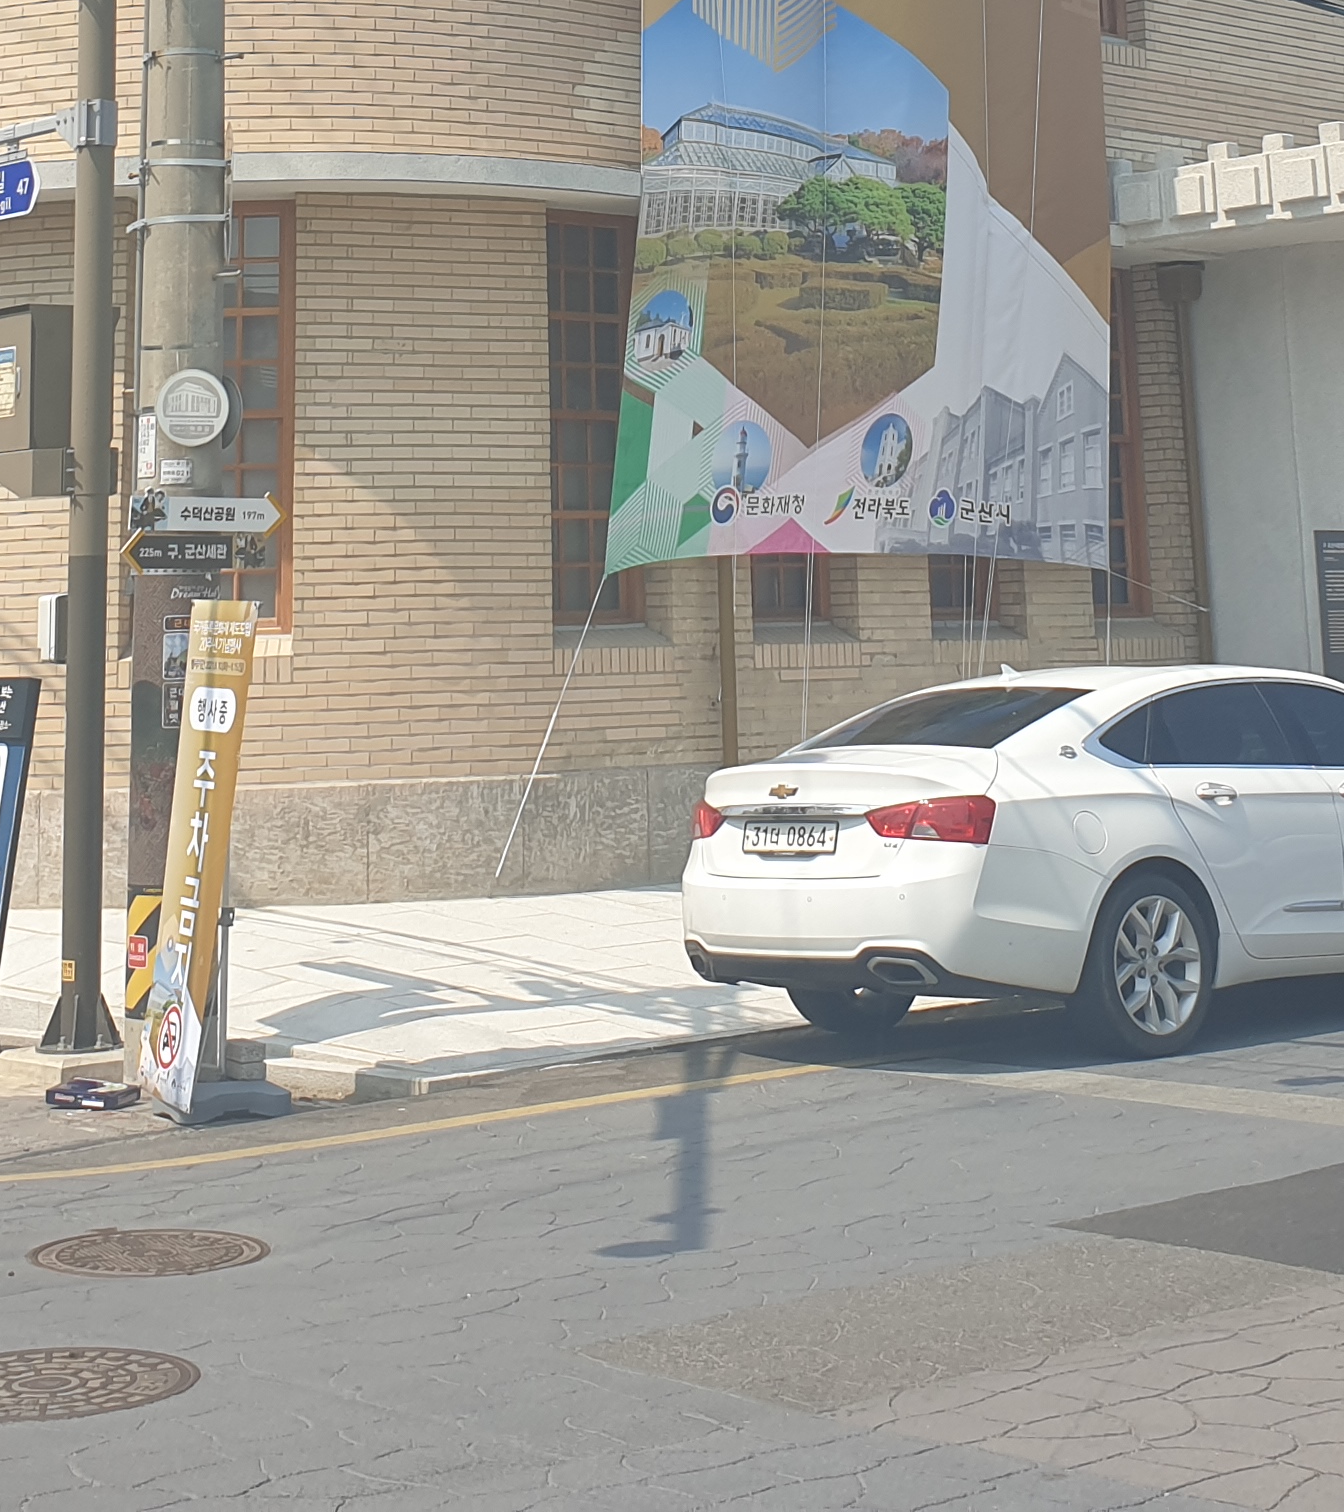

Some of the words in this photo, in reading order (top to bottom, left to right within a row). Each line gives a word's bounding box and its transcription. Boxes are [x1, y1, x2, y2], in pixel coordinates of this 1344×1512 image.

[16, 177, 30, 196] 47
[180, 506, 237, 522] 수덕산공원
[242, 510, 265, 521] 197m
[745, 494, 806, 517] 문화재청
[853, 497, 911, 521] 전라북도
[960, 499, 1013, 526] 군산시
[139, 547, 163, 559] 225m
[167, 544, 183, 560] 구.
[184, 543, 228, 560] 군산세관
[197, 697, 229, 725] 행사중
[752, 825, 780, 847] 31더
[787, 825, 826, 847] 0864
[169, 749, 217, 1004] 주차금지
